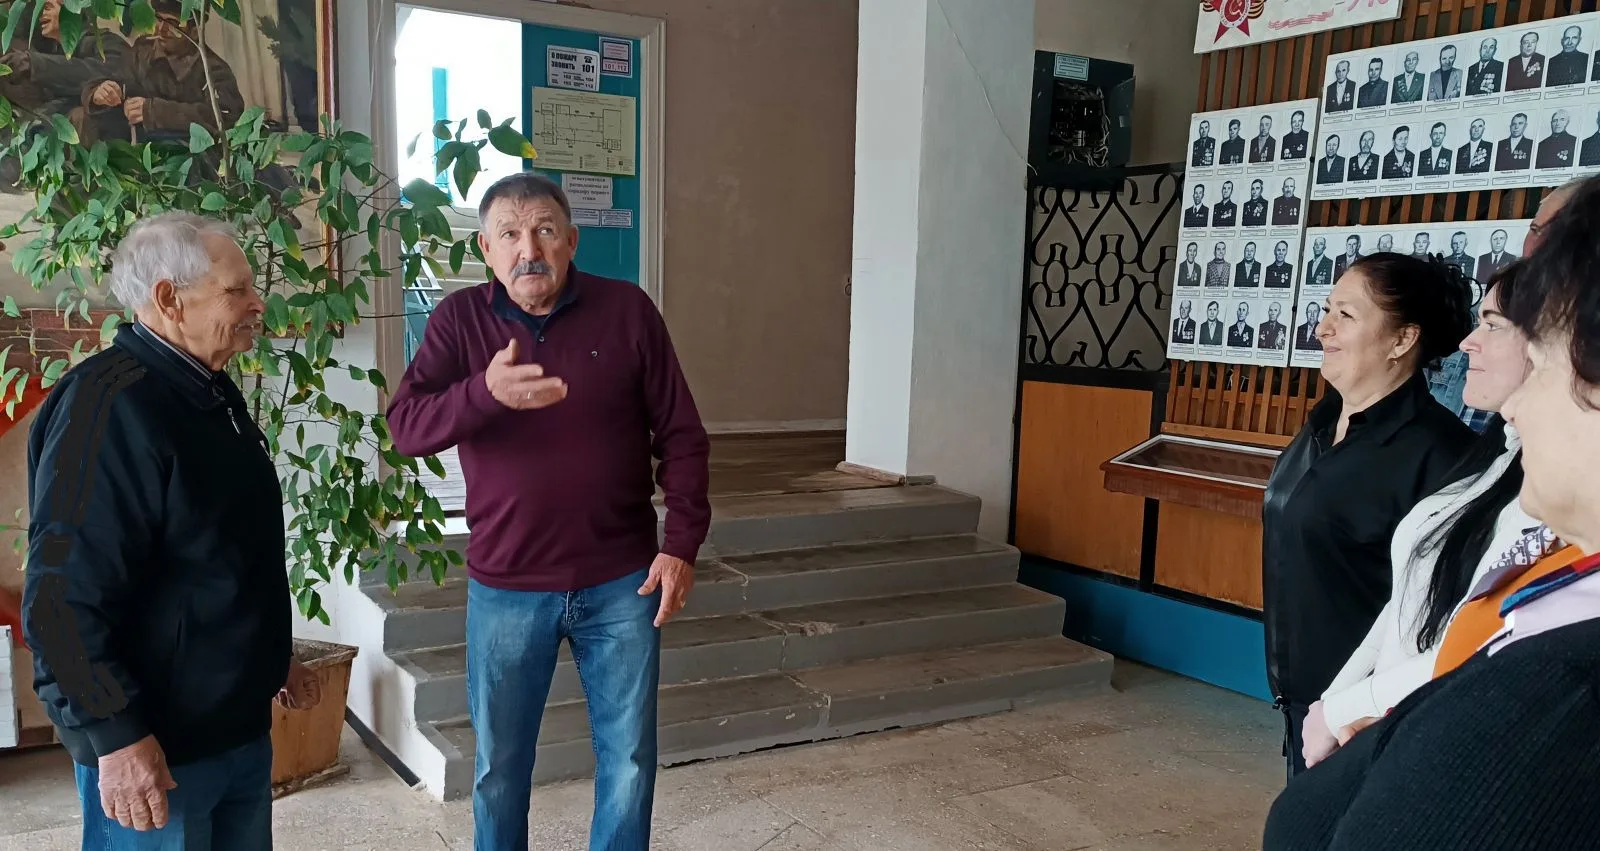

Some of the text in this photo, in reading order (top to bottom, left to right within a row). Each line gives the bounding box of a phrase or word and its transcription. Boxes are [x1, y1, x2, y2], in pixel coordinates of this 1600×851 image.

[556, 53, 577, 61] ПОЖАРЕ
[551, 60, 576, 70] ЗВОНИТЬ
[582, 64, 595, 73] 101
